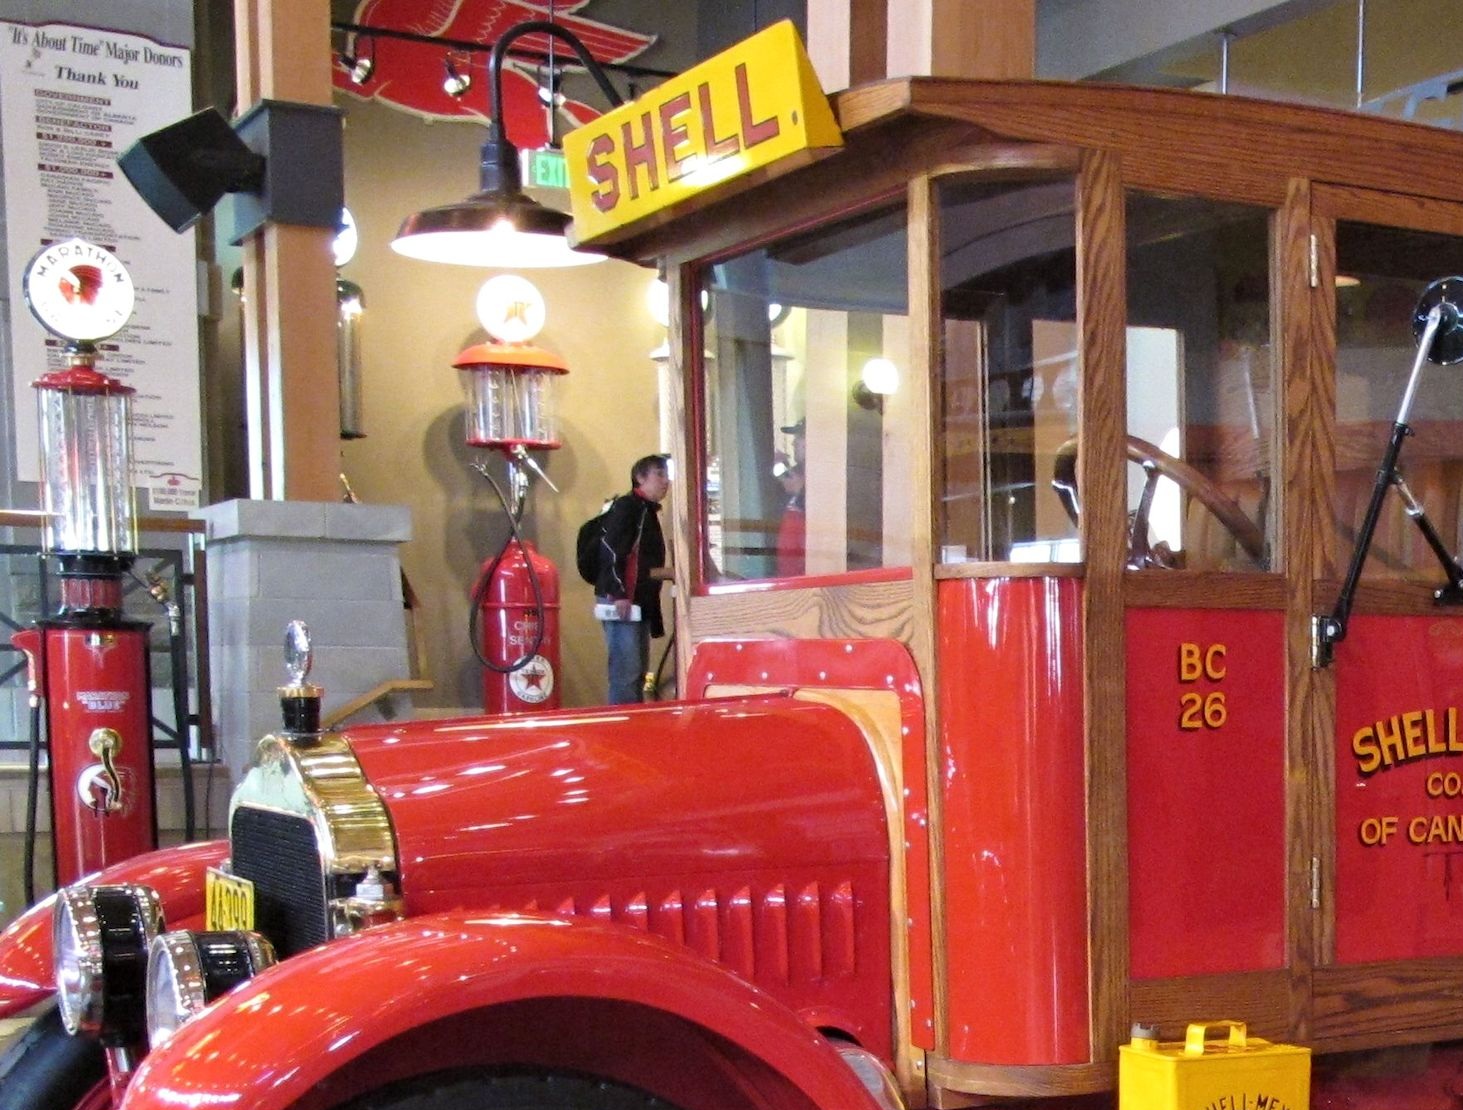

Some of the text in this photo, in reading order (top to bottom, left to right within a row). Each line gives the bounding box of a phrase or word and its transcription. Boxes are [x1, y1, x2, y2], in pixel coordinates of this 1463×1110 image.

[33, 30, 66, 51] About
[71, 35, 104, 56] Time"
[106, 41, 139, 64] Major
[143, 47, 183, 68] Donors
[55, 65, 139, 90] Thank You
[587, 63, 780, 213] SHELL
[37, 245, 125, 283] MARATHON
[1180, 642, 1227, 682] BC
[1180, 691, 1227, 729] 26
[1360, 816, 1399, 845] OF
